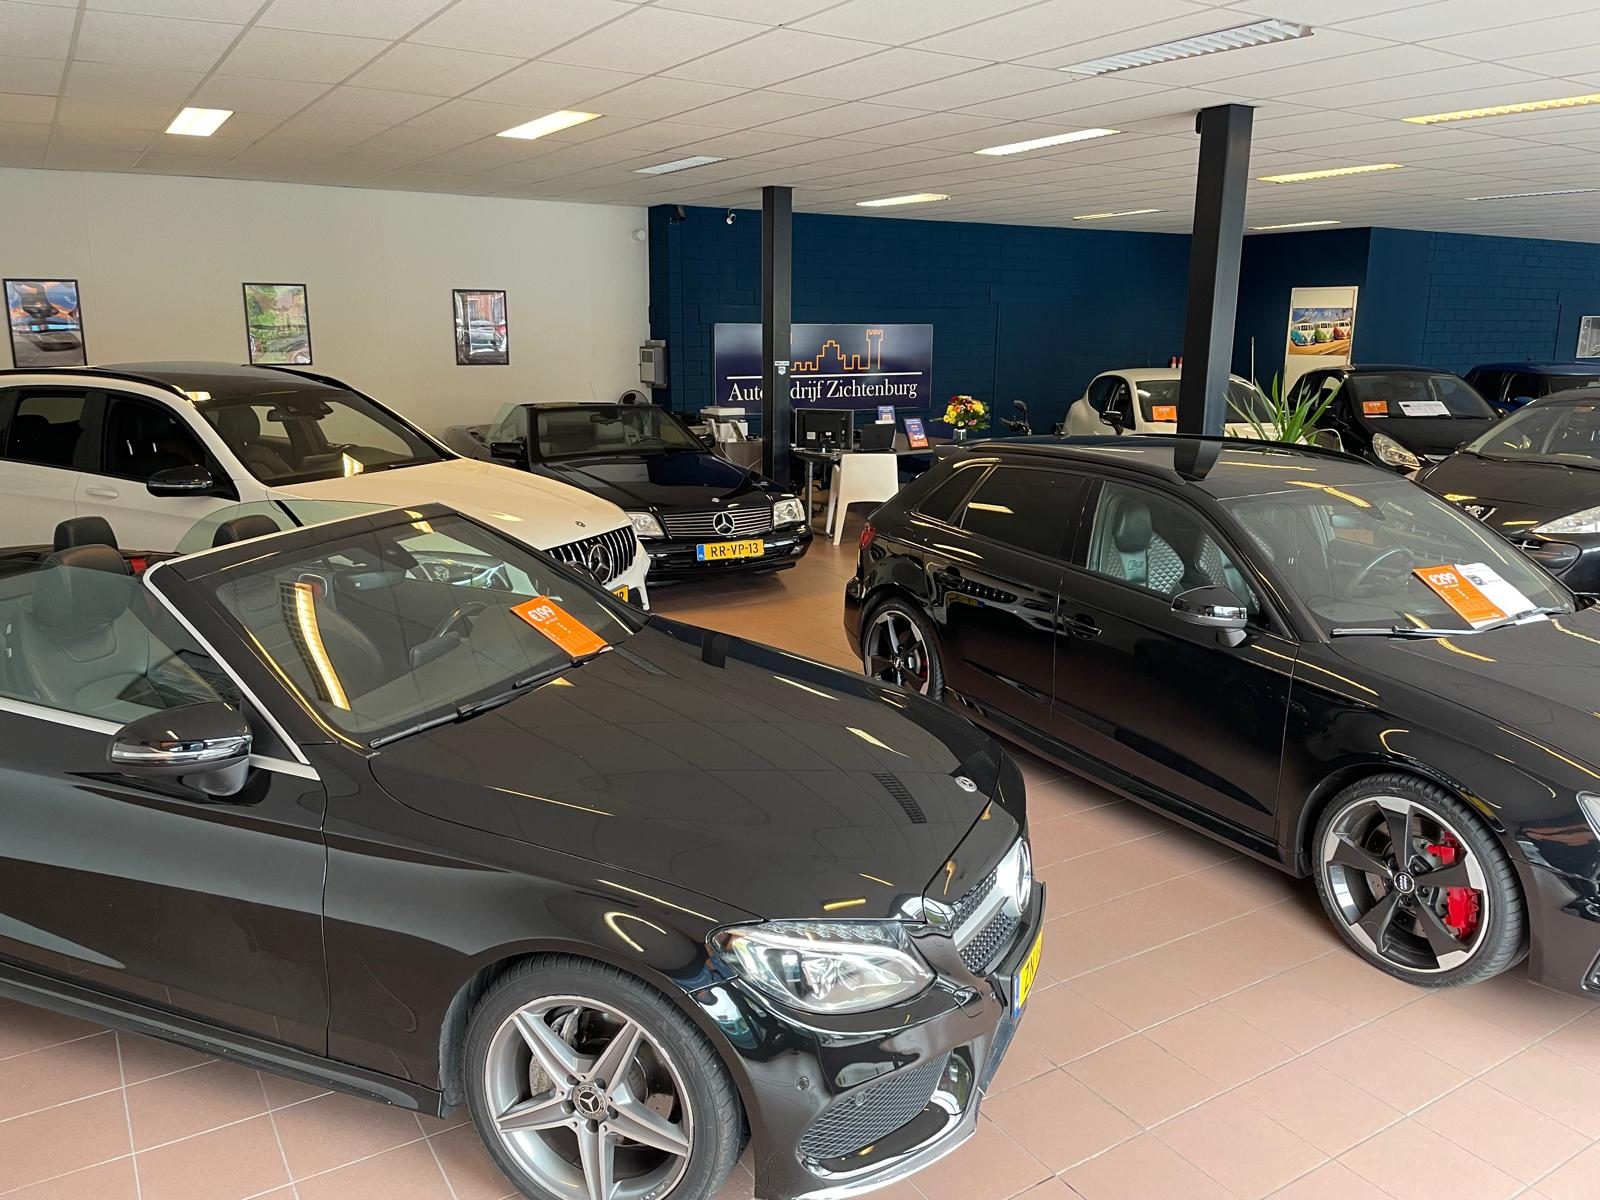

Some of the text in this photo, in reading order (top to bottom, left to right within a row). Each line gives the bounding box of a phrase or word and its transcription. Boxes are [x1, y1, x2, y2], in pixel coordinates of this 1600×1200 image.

[728, 378, 918, 402] Autdrijf Zichtenburg
[711, 543, 759, 557] RR-VP-13
